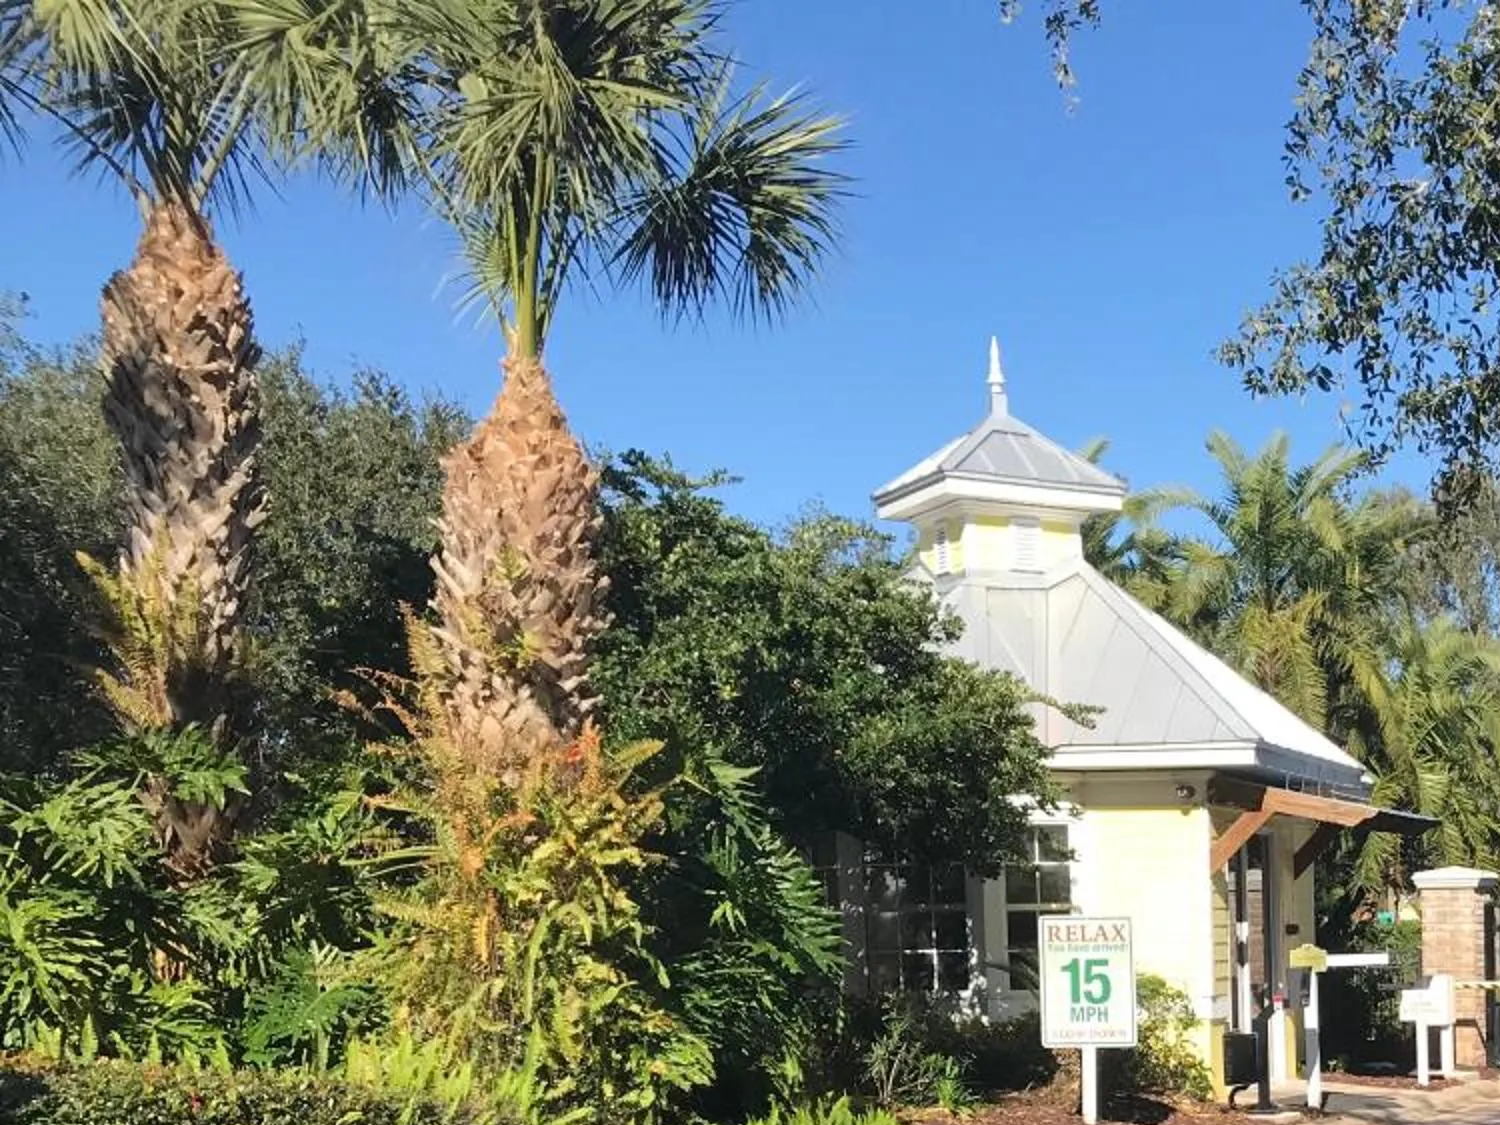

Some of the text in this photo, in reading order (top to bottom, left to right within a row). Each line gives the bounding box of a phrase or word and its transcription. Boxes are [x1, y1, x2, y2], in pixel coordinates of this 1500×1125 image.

[1047, 923, 1127, 942] RELAX
[1061, 958, 1112, 1005] 15
[1070, 1006, 1109, 1022] MPH
